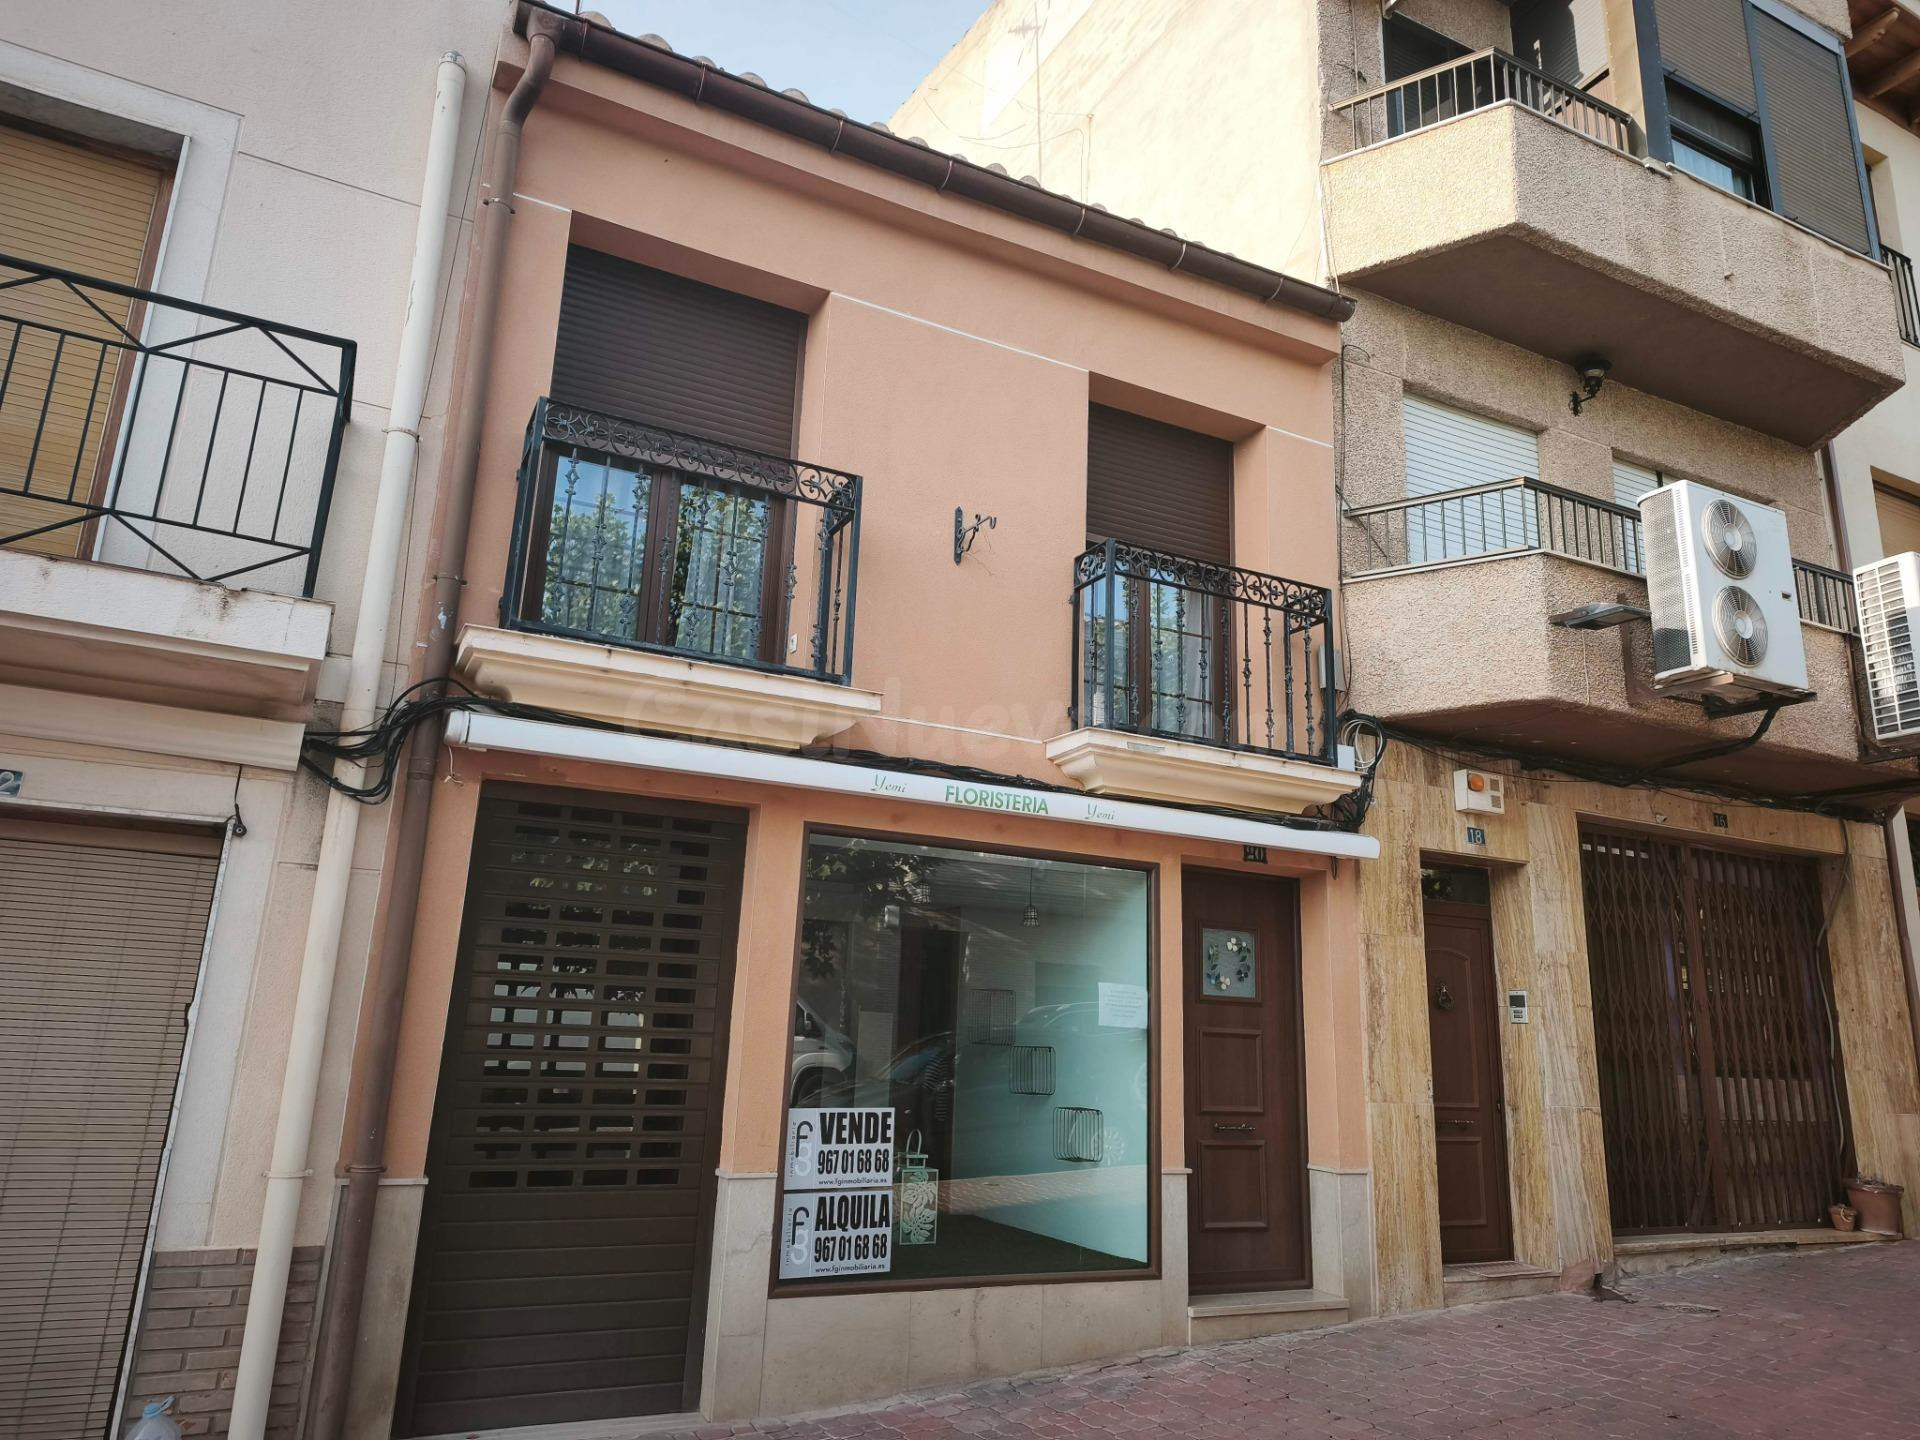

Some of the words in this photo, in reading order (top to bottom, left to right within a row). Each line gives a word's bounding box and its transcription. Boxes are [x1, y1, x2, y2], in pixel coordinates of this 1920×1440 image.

[871, 774, 907, 793] Yemi
[945, 785, 1049, 815] FLORISTERIA
[1084, 803, 1116, 821] Yemi
[1469, 829, 1483, 844] 18
[819, 1112, 892, 1145] VENDE
[818, 1150, 839, 1174] 967
[842, 1149, 854, 1174] 01
[857, 1149, 872, 1174] 68
[874, 1148, 889, 1173] 68
[818, 1176, 888, 1187] www.fginmobiliaria.es
[815, 1194, 890, 1232] ALQUILA
[814, 1237, 836, 1262] 967
[838, 1235, 852, 1261] 01
[854, 1234, 870, 1260] 68
[872, 1233, 887, 1259] 68
[815, 1263, 885, 1274] www.fginmobiliaria.es
